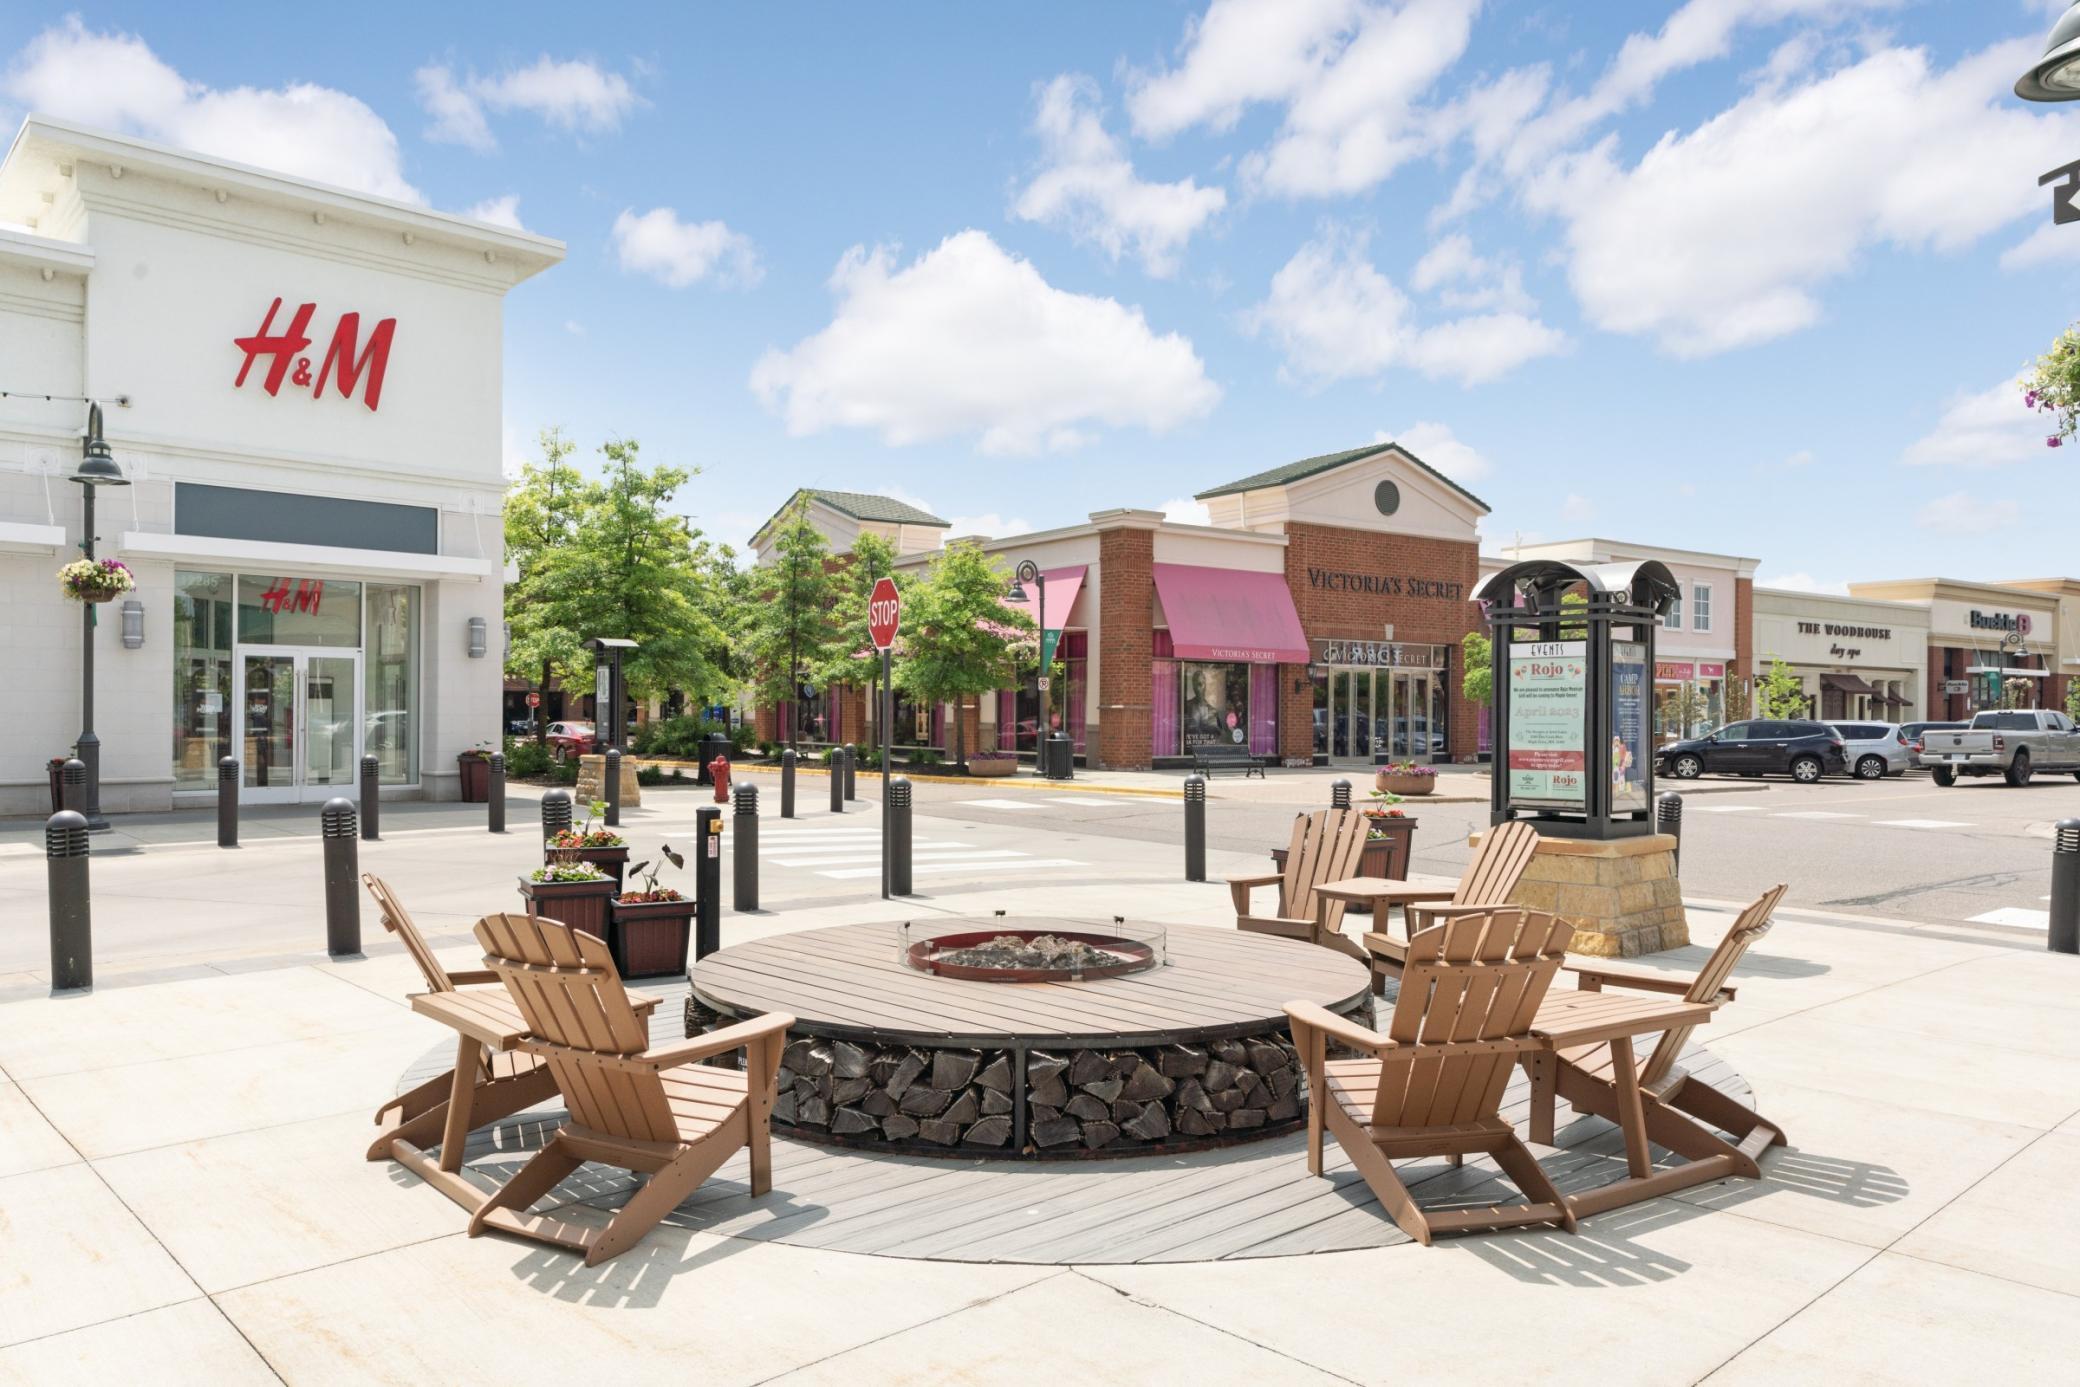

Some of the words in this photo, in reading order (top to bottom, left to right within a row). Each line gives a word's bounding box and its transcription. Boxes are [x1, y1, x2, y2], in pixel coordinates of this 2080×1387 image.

[234, 297, 397, 412] H&M
[1307, 567, 1402, 595] VICTORIA'S
[1407, 577, 1464, 600] SECRET
[260, 577, 325, 616] H&M
[871, 600, 898, 628] STOP
[1970, 610, 2017, 631] Buckle
[1798, 622, 1821, 634] THE
[1824, 624, 1891, 640] WOODHOUSE
[1212, 648, 1250, 658] VICTORIA'S
[1251, 651, 1275, 660] SECRET
[1531, 643, 1564, 656] EVENTS
[1830, 643, 1845, 659] day
[1847, 648, 1861, 659] spa
[1531, 662, 1564, 678] Rojo
[1553, 774, 1577, 786] Rojo
